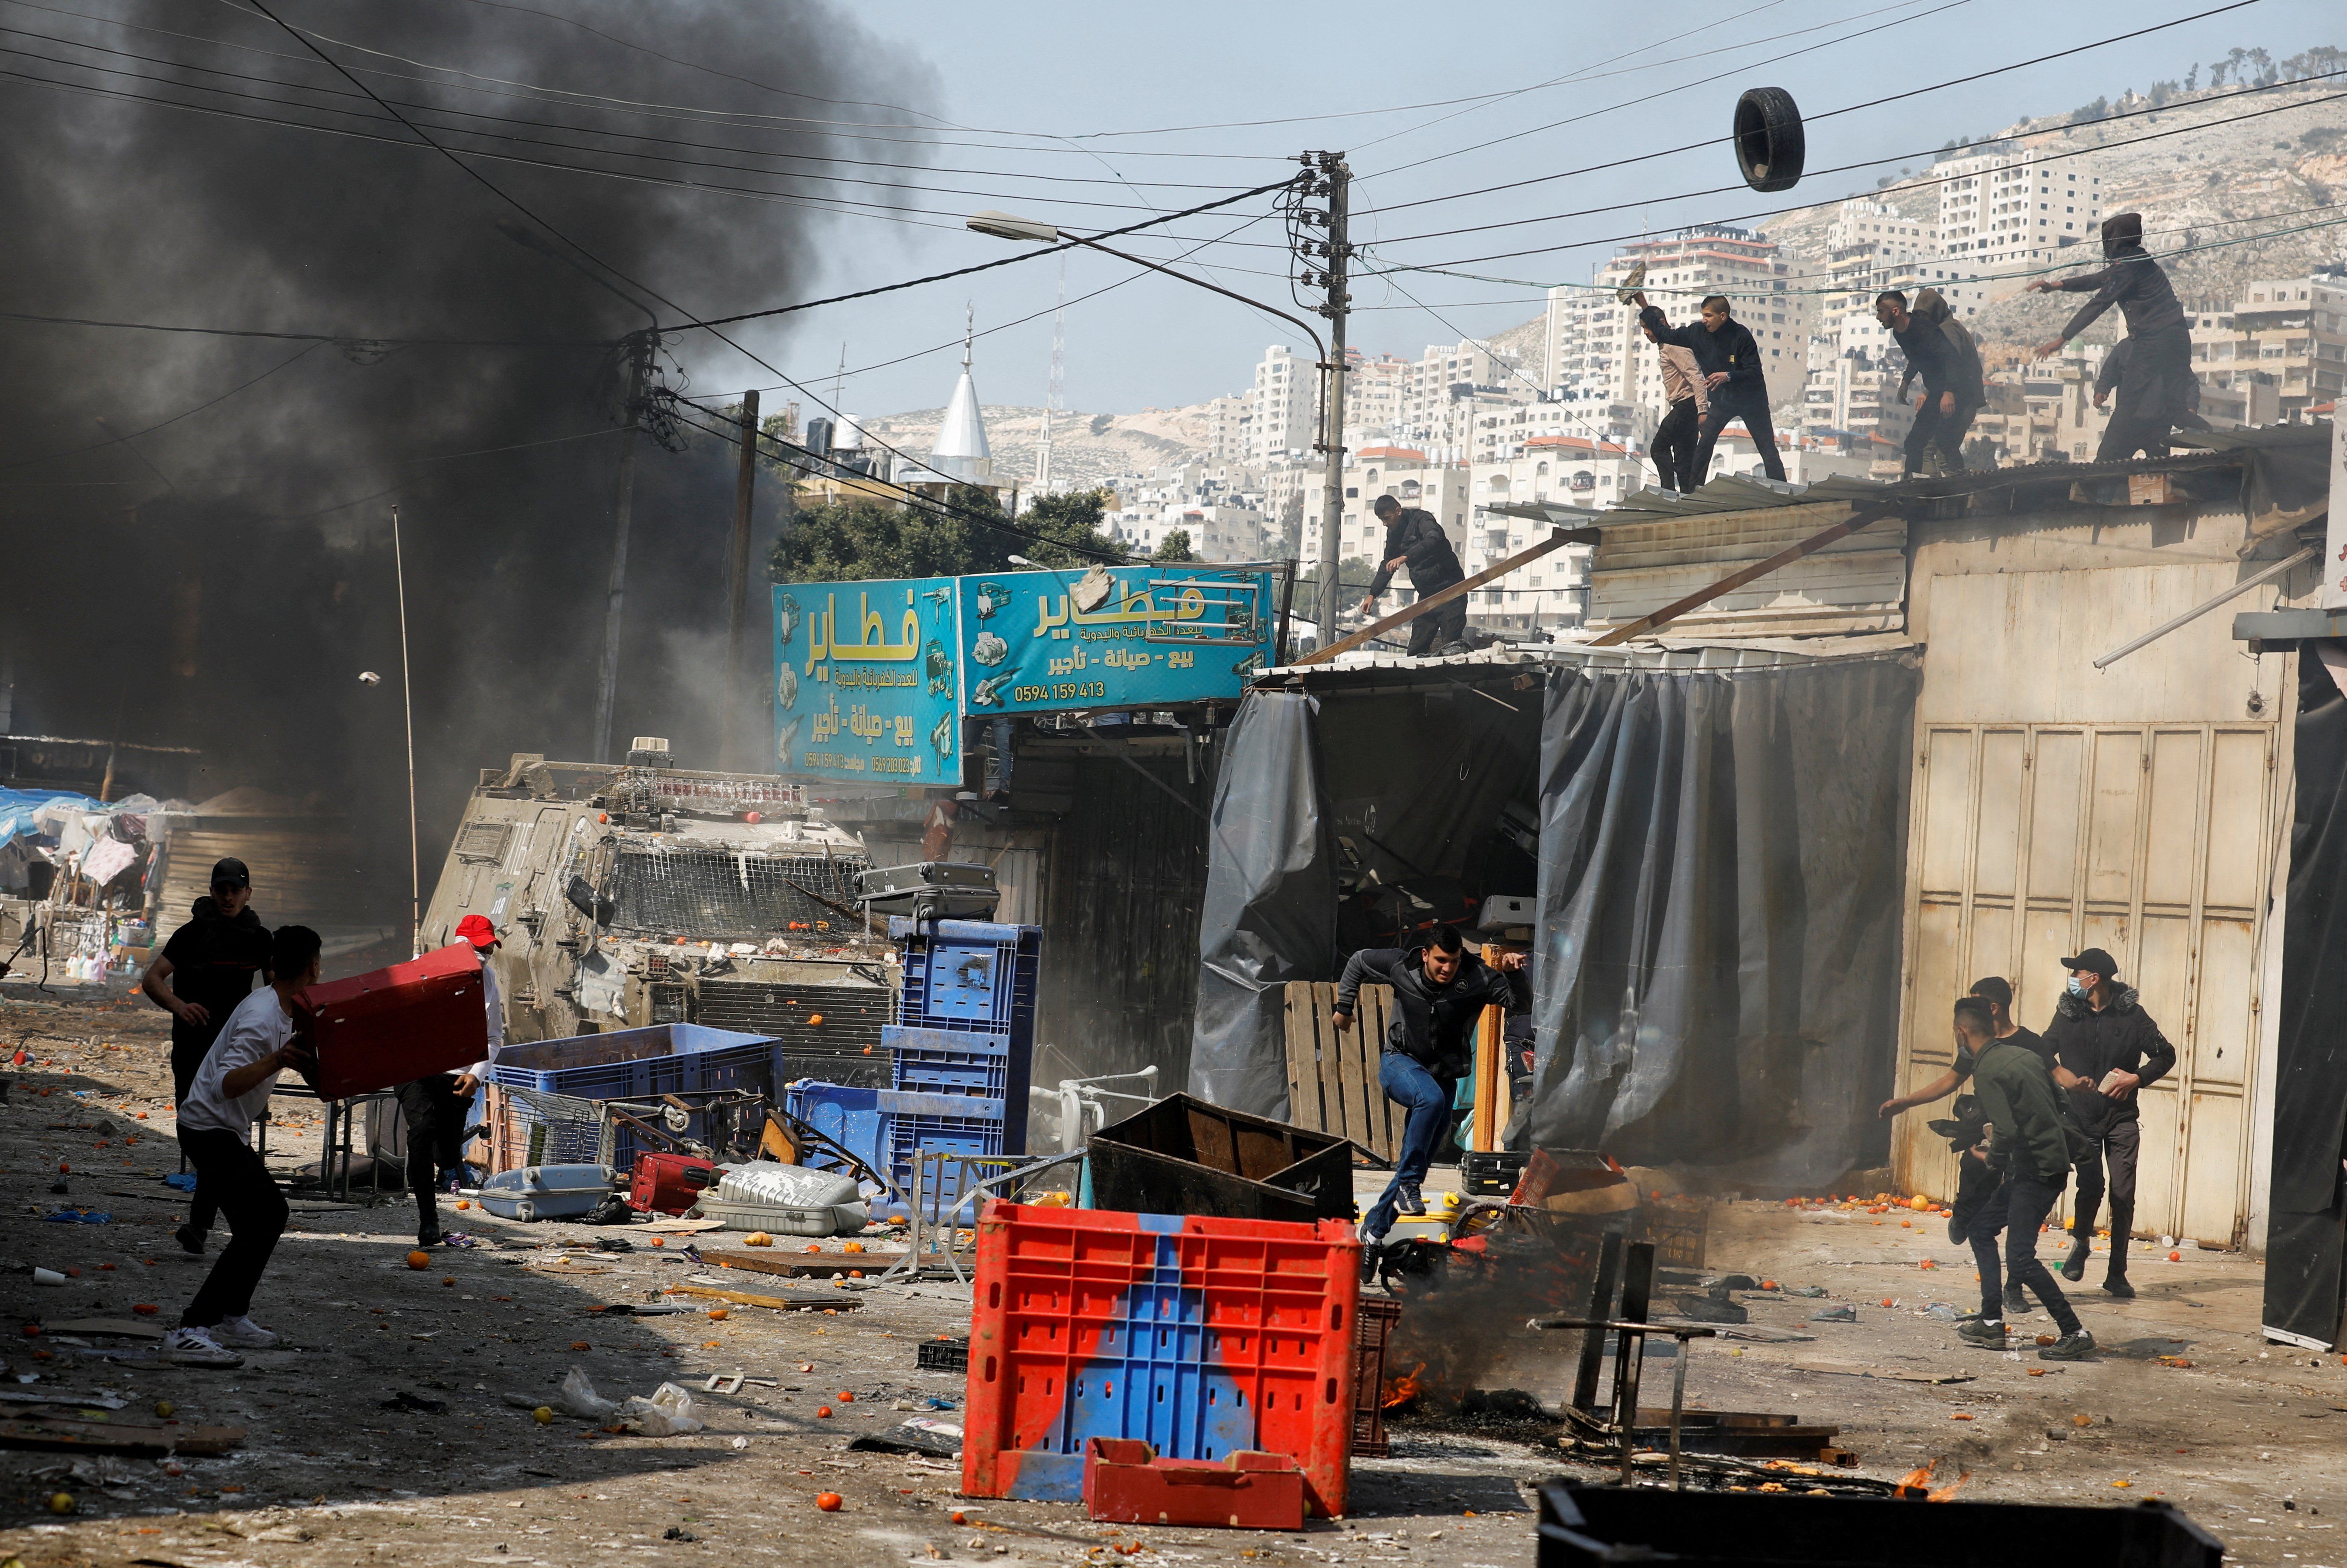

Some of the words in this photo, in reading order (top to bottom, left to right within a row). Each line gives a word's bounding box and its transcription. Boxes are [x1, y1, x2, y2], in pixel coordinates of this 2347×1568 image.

[806, 589, 920, 681] فطاير
[1080, 628, 1119, 642] واليدوية
[1048, 645, 1087, 676] تأجير
[1104, 649, 1150, 671] صيانة
[1168, 651, 1194, 669] بيع
[835, 666, 862, 691] واليدوية
[862, 666, 896, 691] الكهربائية
[897, 669, 918, 687] للعدد
[1014, 685, 1049, 702] 0594
[1052, 683, 1076, 700] 159
[1079, 681, 1105, 698] 413
[812, 692, 839, 742] تأجير
[850, 704, 882, 745] صيانة
[895, 715, 913, 746] بيع
[805, 752, 820, 767] 0594
[821, 752, 832, 768] 159
[833, 753, 844, 769] 413
[872, 756, 886, 772] 0569
[887, 757, 898, 773] 203
[899, 757, 909, 773] 023
